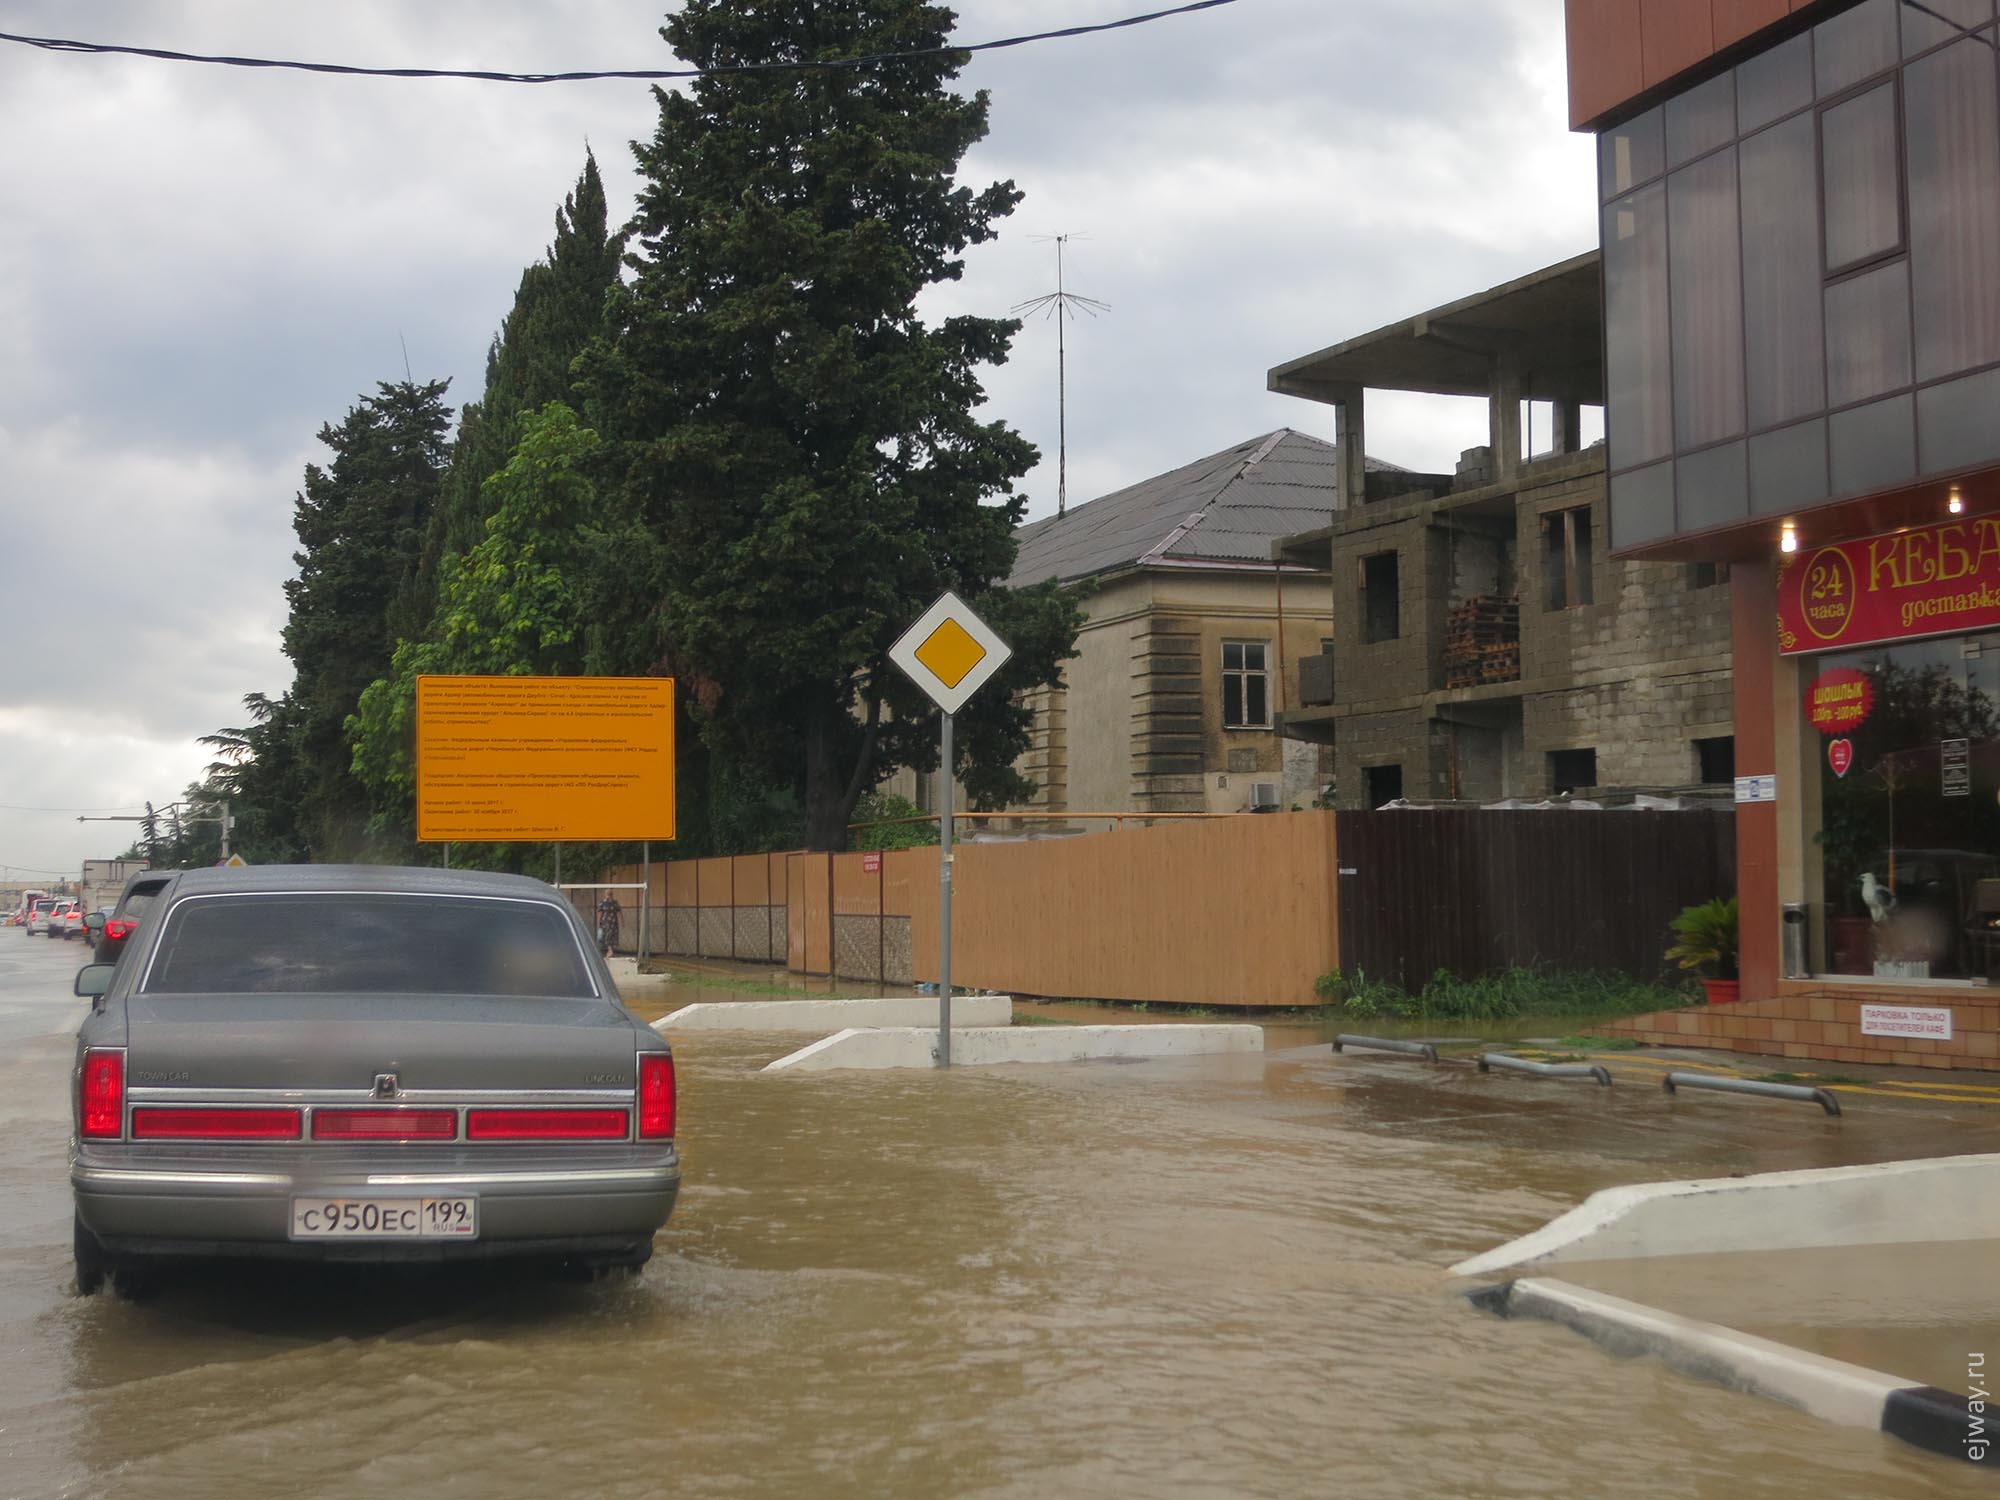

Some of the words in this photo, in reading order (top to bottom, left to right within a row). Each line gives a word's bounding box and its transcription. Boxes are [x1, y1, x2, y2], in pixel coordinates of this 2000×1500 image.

[1811, 564, 1843, 599] 24
[1809, 602, 1845, 620] часа
[1865, 1009, 1908, 1020] ПАРКОВКА
[1911, 1011, 1946, 1022] ТОЛЬКО
[303, 1203, 417, 1231] С950ЕС
[425, 1201, 468, 1224] 199
